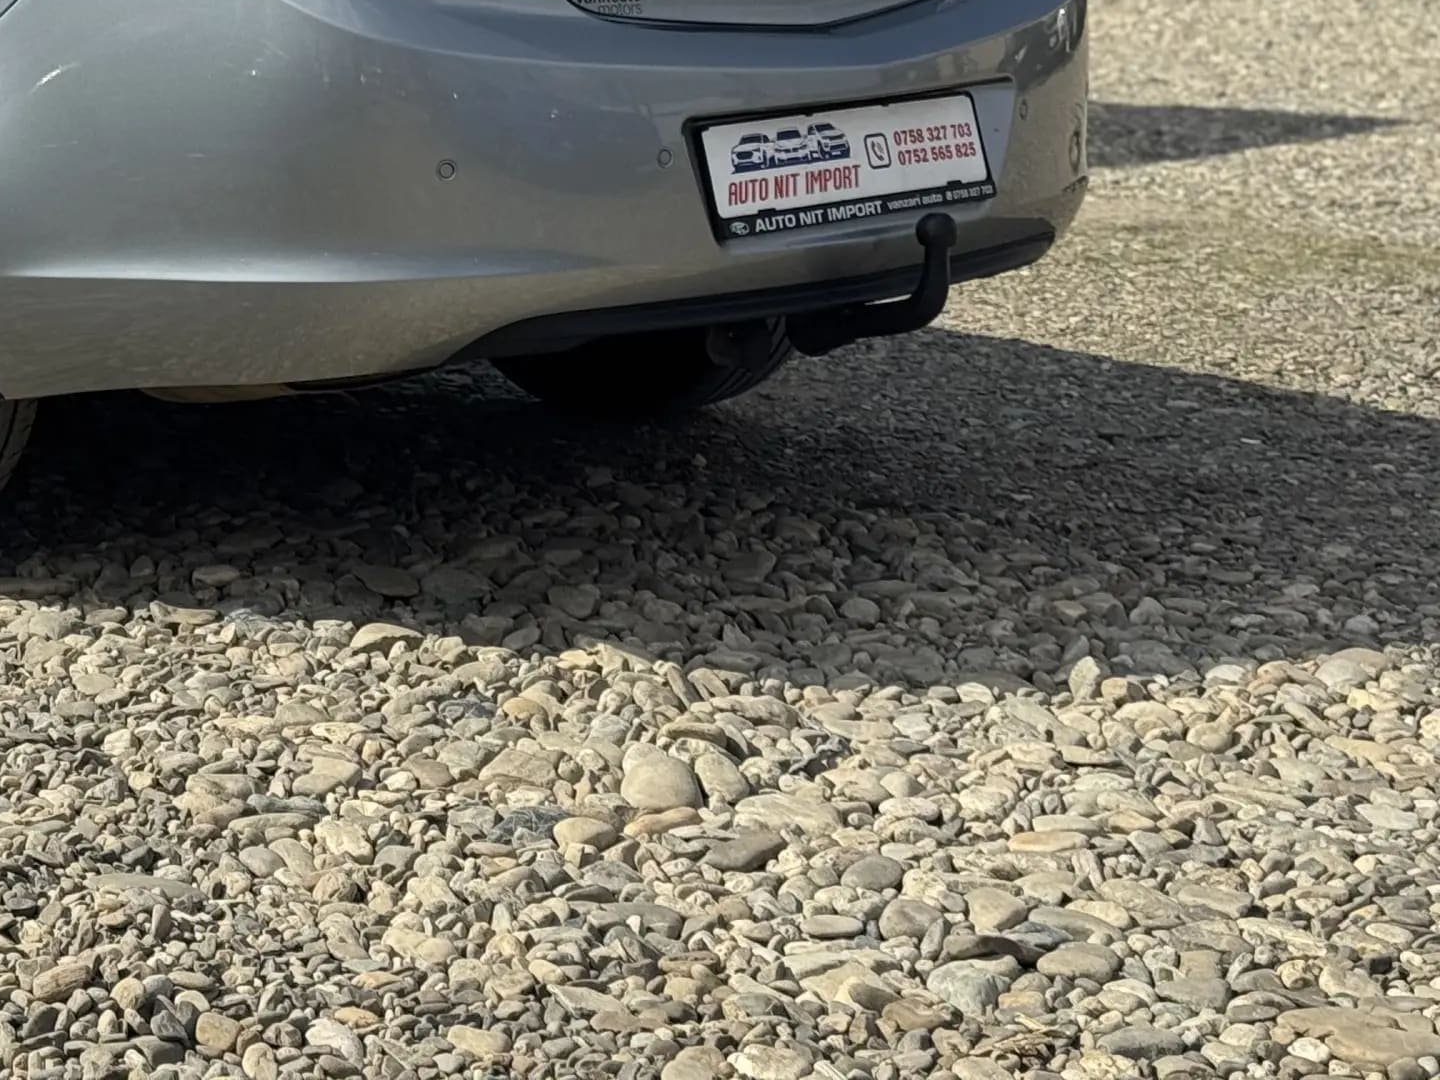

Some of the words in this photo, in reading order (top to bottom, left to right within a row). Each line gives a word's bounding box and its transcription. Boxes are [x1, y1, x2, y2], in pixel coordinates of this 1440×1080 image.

[598, 3, 642, 16] motors
[893, 128, 925, 146] 0758
[926, 125, 948, 141] 327
[950, 122, 972, 138] 703
[898, 147, 929, 166] 0752
[931, 144, 953, 161] 565
[955, 141, 977, 158] 825
[728, 177, 769, 207] AUTO
[774, 172, 800, 199] NIT
[805, 164, 861, 195] IMPORT
[754, 213, 796, 233] AUTO
[799, 209, 824, 226] NIT
[827, 200, 882, 222] IMPORT
